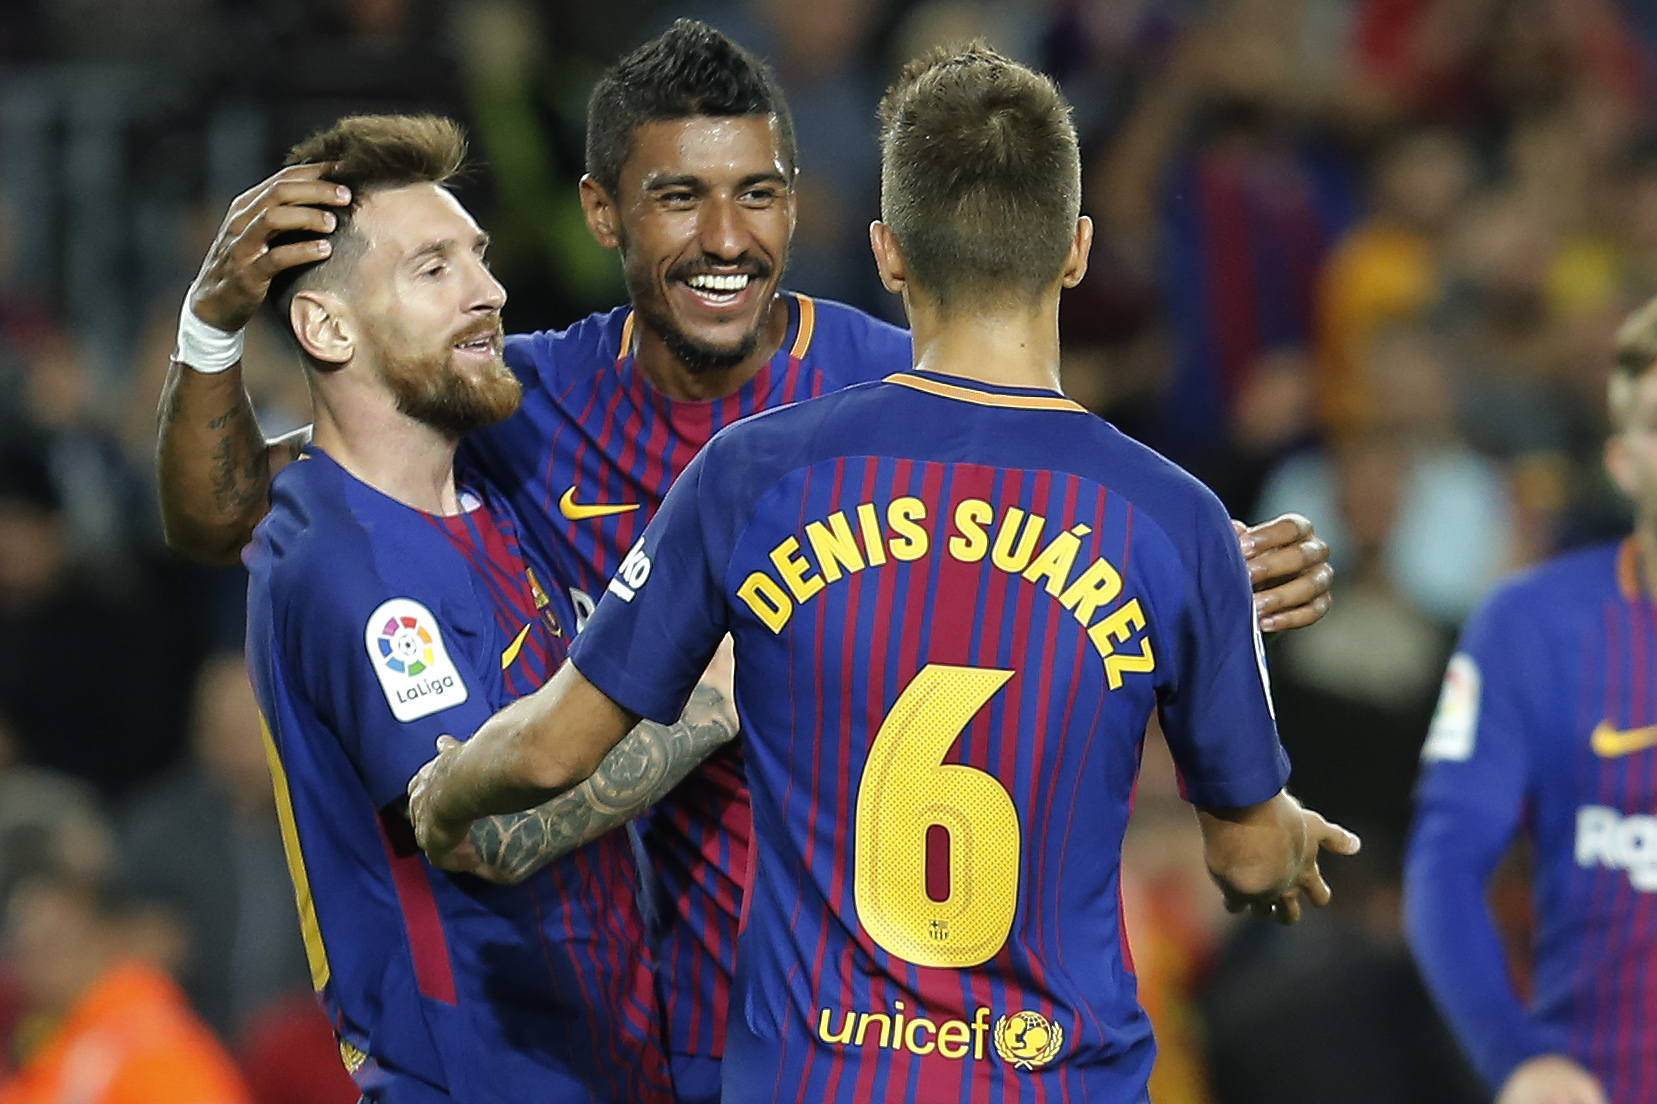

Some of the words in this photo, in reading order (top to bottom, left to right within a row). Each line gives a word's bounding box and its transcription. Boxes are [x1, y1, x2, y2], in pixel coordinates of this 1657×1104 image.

[737, 497, 929, 634] DENIS
[949, 498, 1155, 690] SUÁREZ
[396, 675, 454, 704] LaLiga
[854, 664, 1020, 968] 6
[817, 1000, 992, 1060] unicef
